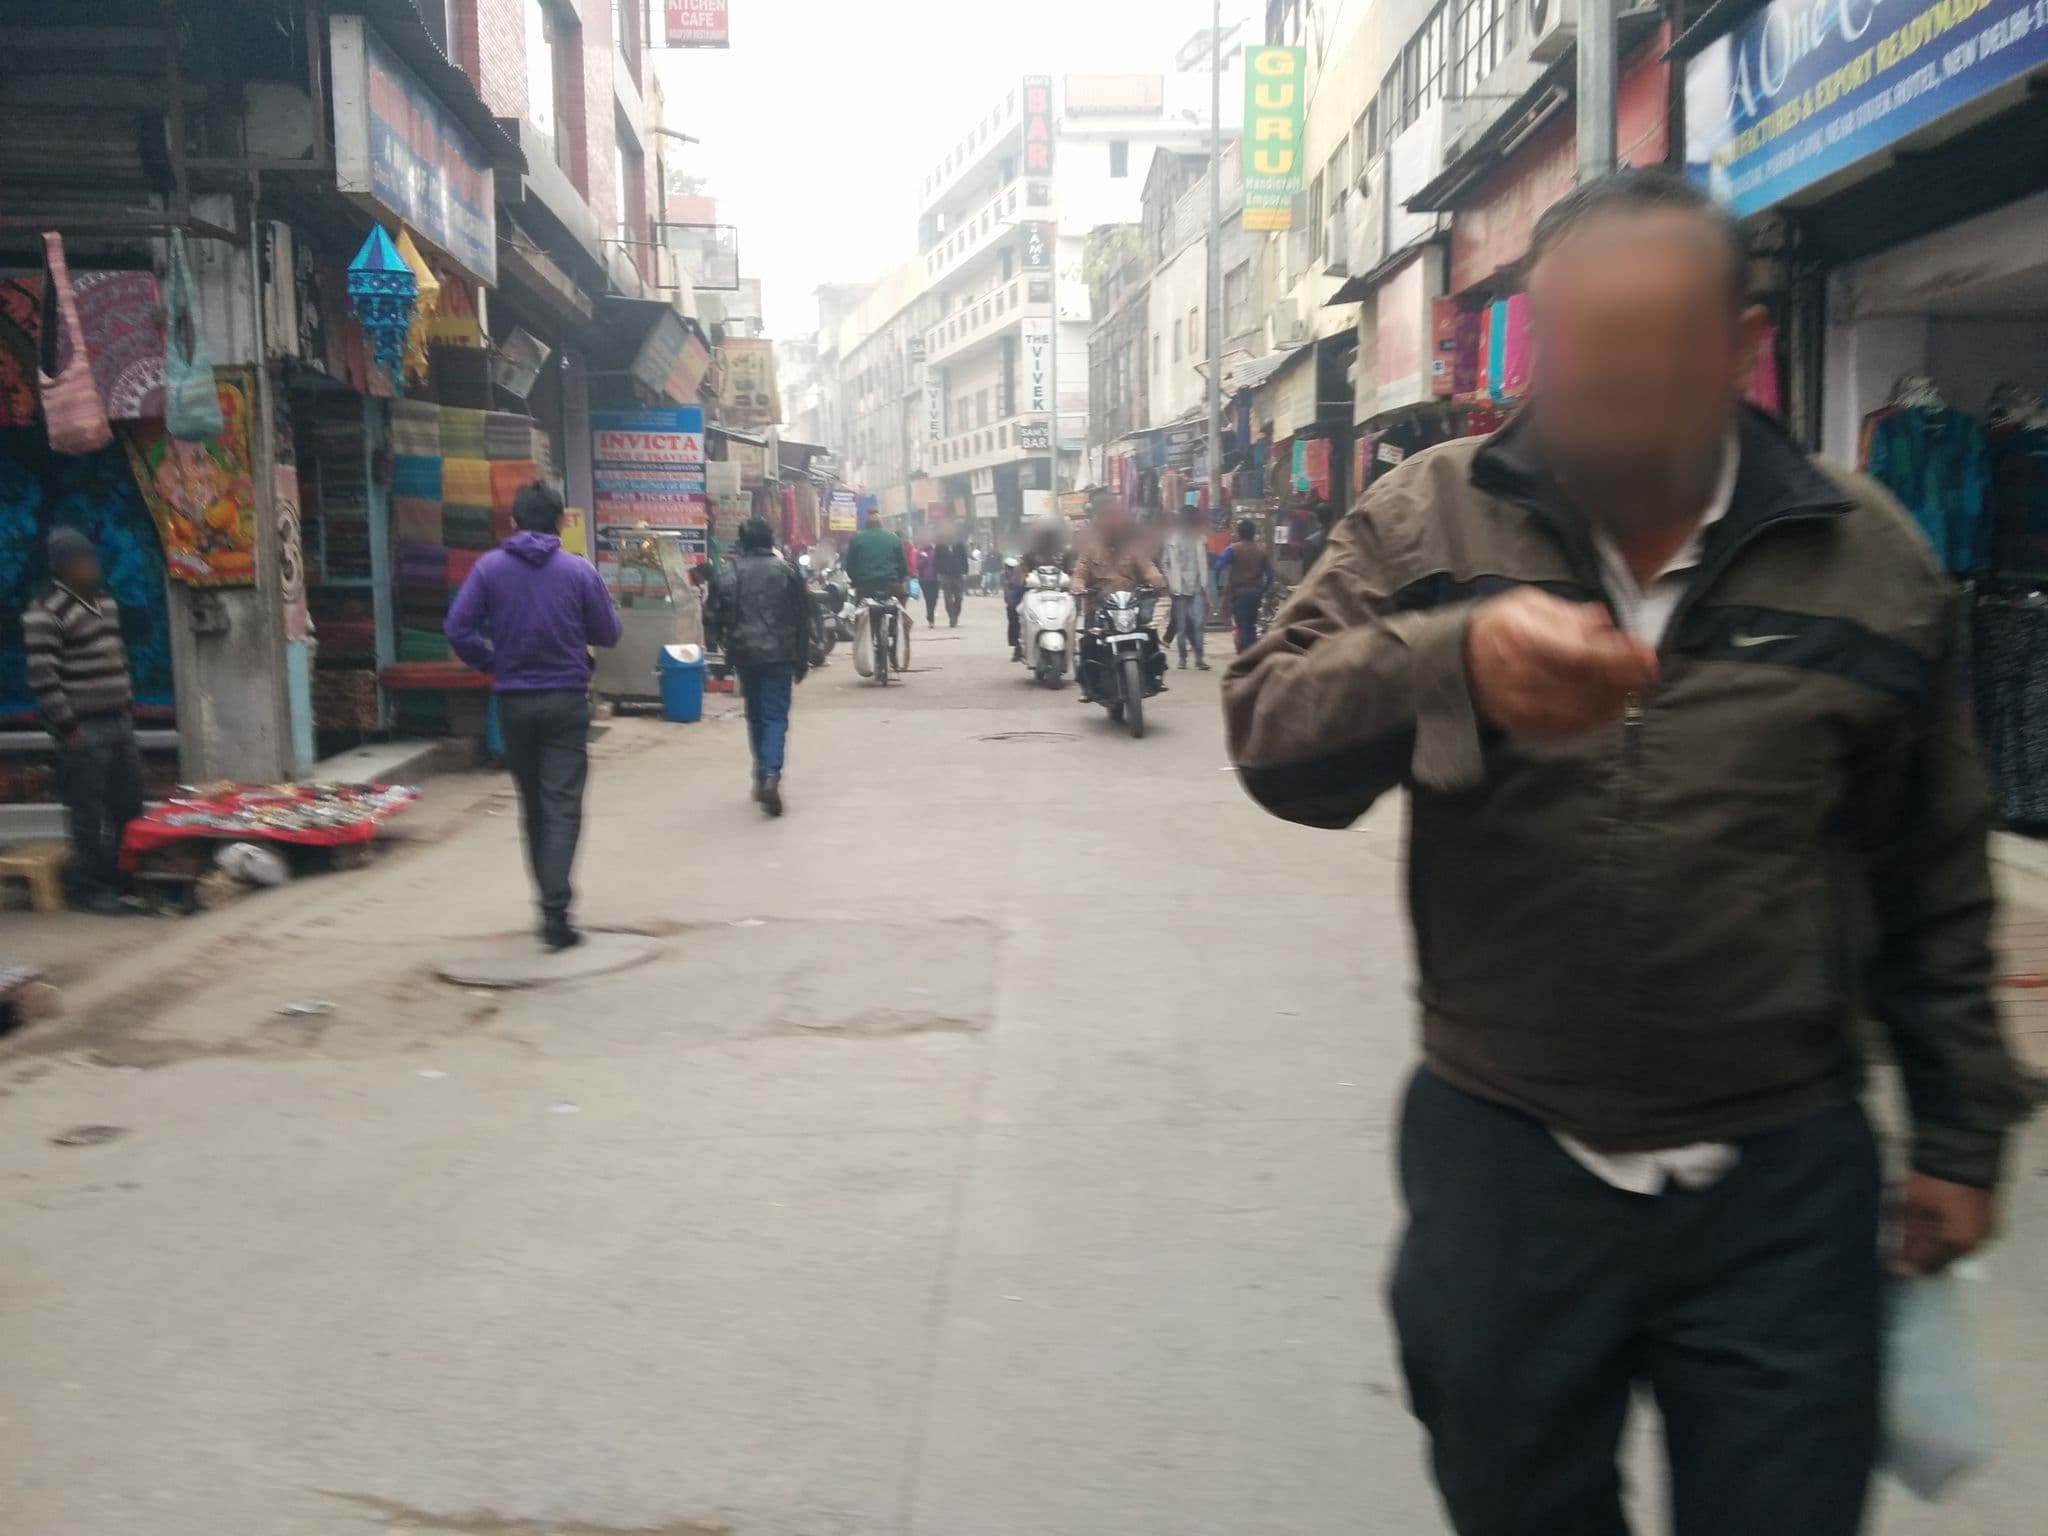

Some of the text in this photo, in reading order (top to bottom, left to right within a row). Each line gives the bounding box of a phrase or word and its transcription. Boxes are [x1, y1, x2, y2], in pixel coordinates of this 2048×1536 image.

[668, 0, 727, 11] KITCHEN
[680, 11, 714, 27] CAFE
[1254, 49, 1296, 175] GURU
[1027, 87, 1049, 169] BAR
[1025, 334, 1049, 344] THE
[1032, 347, 1045, 410] VIVEK
[928, 390, 941, 440] VIVEK
[600, 434, 698, 450] INVICTA
[1022, 437, 1049, 450] BAR
[647, 453, 698, 463] TRAVELS
[638, 493, 690, 503] TICKETS
